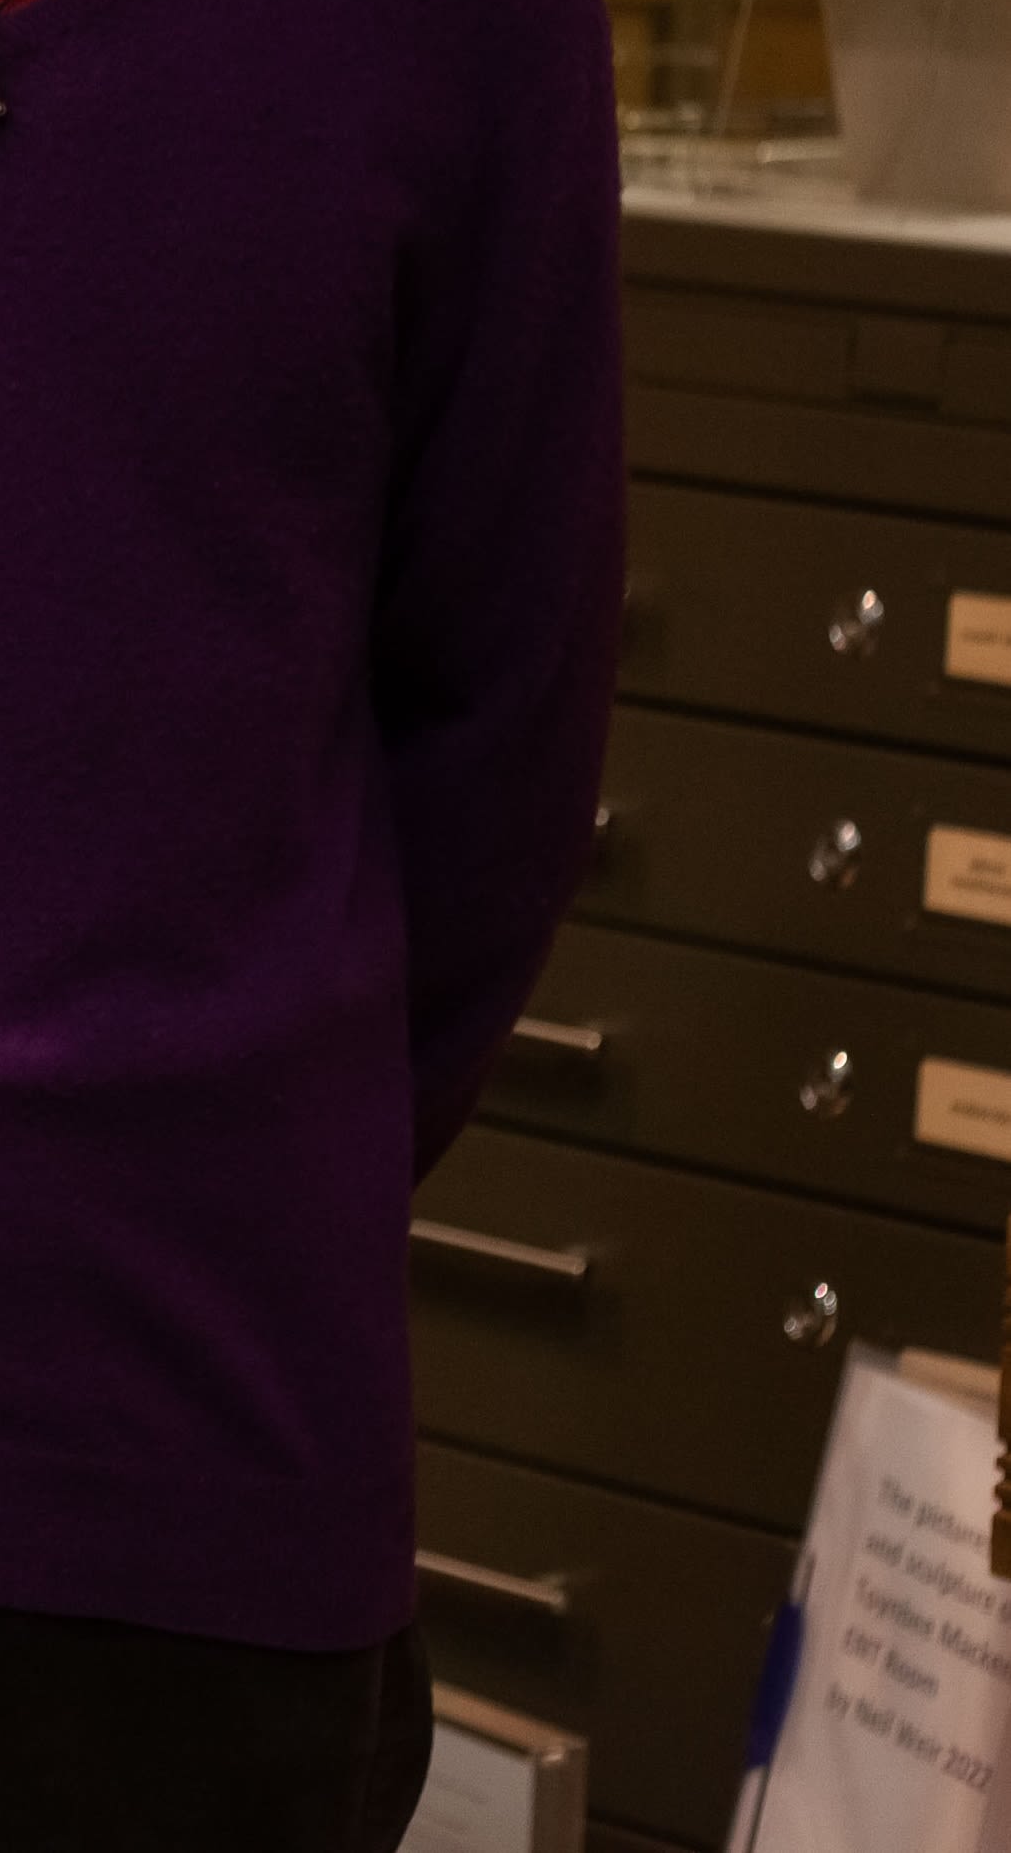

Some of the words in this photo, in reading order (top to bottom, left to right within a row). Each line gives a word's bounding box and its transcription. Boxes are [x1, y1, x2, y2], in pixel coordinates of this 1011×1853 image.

[879, 1475, 914, 1520] The
[865, 1531, 903, 1567] and
[883, 1647, 939, 1698] Room
[824, 1681, 851, 1721] by
[941, 1743, 994, 1794] 2022
